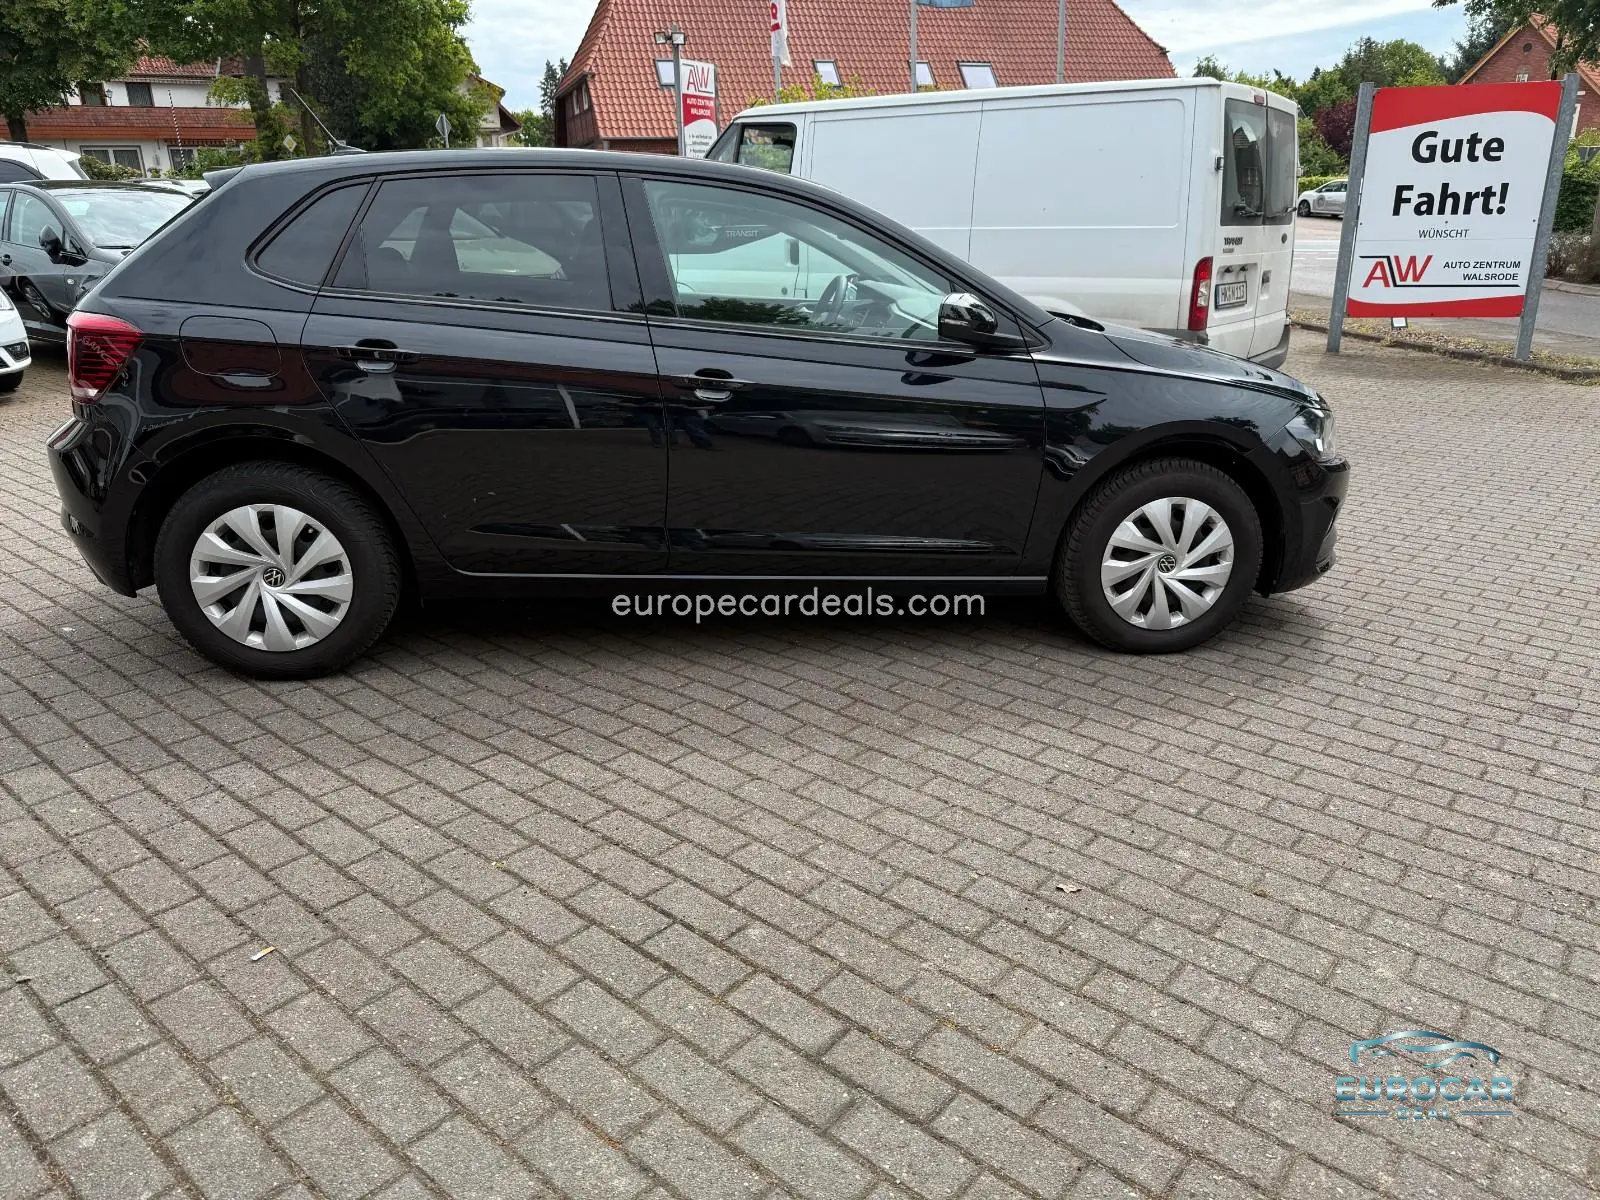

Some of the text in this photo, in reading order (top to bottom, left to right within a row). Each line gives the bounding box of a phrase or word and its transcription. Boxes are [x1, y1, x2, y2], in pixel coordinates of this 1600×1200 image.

[1411, 130, 1505, 164] Gute
[1392, 182, 1510, 217] Fahrt!
[1418, 227, 1470, 239] WÜNSCHT
[1362, 254, 1433, 288] AW
[1443, 260, 1521, 270] AUTO ZENTRUM
[1462, 272, 1519, 282] WALSRODE
